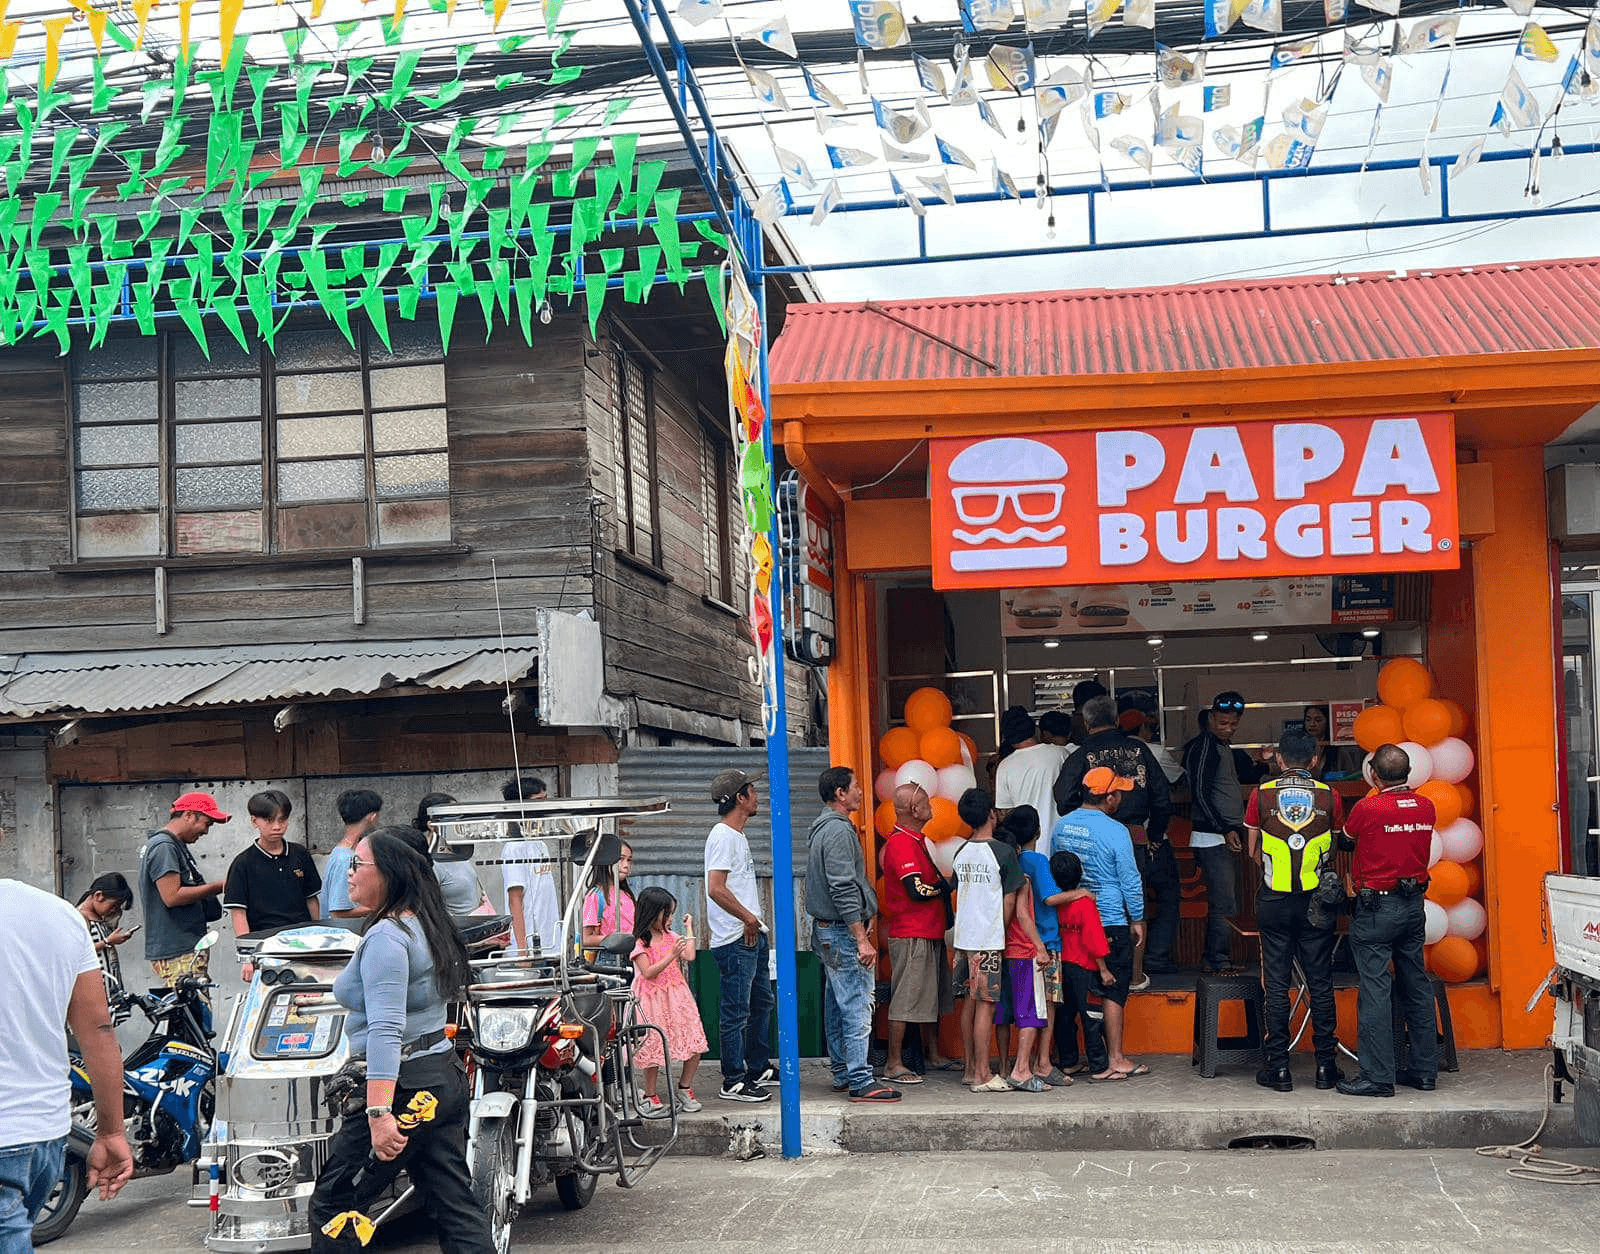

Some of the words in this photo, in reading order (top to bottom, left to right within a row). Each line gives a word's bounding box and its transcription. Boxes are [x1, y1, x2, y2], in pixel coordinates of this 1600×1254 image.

[1096, 418, 1440, 507] PAPA
[1100, 500, 1433, 566] BURGER
[979, 950, 1000, 973] 23
[1072, 1159, 1193, 1178] NO
